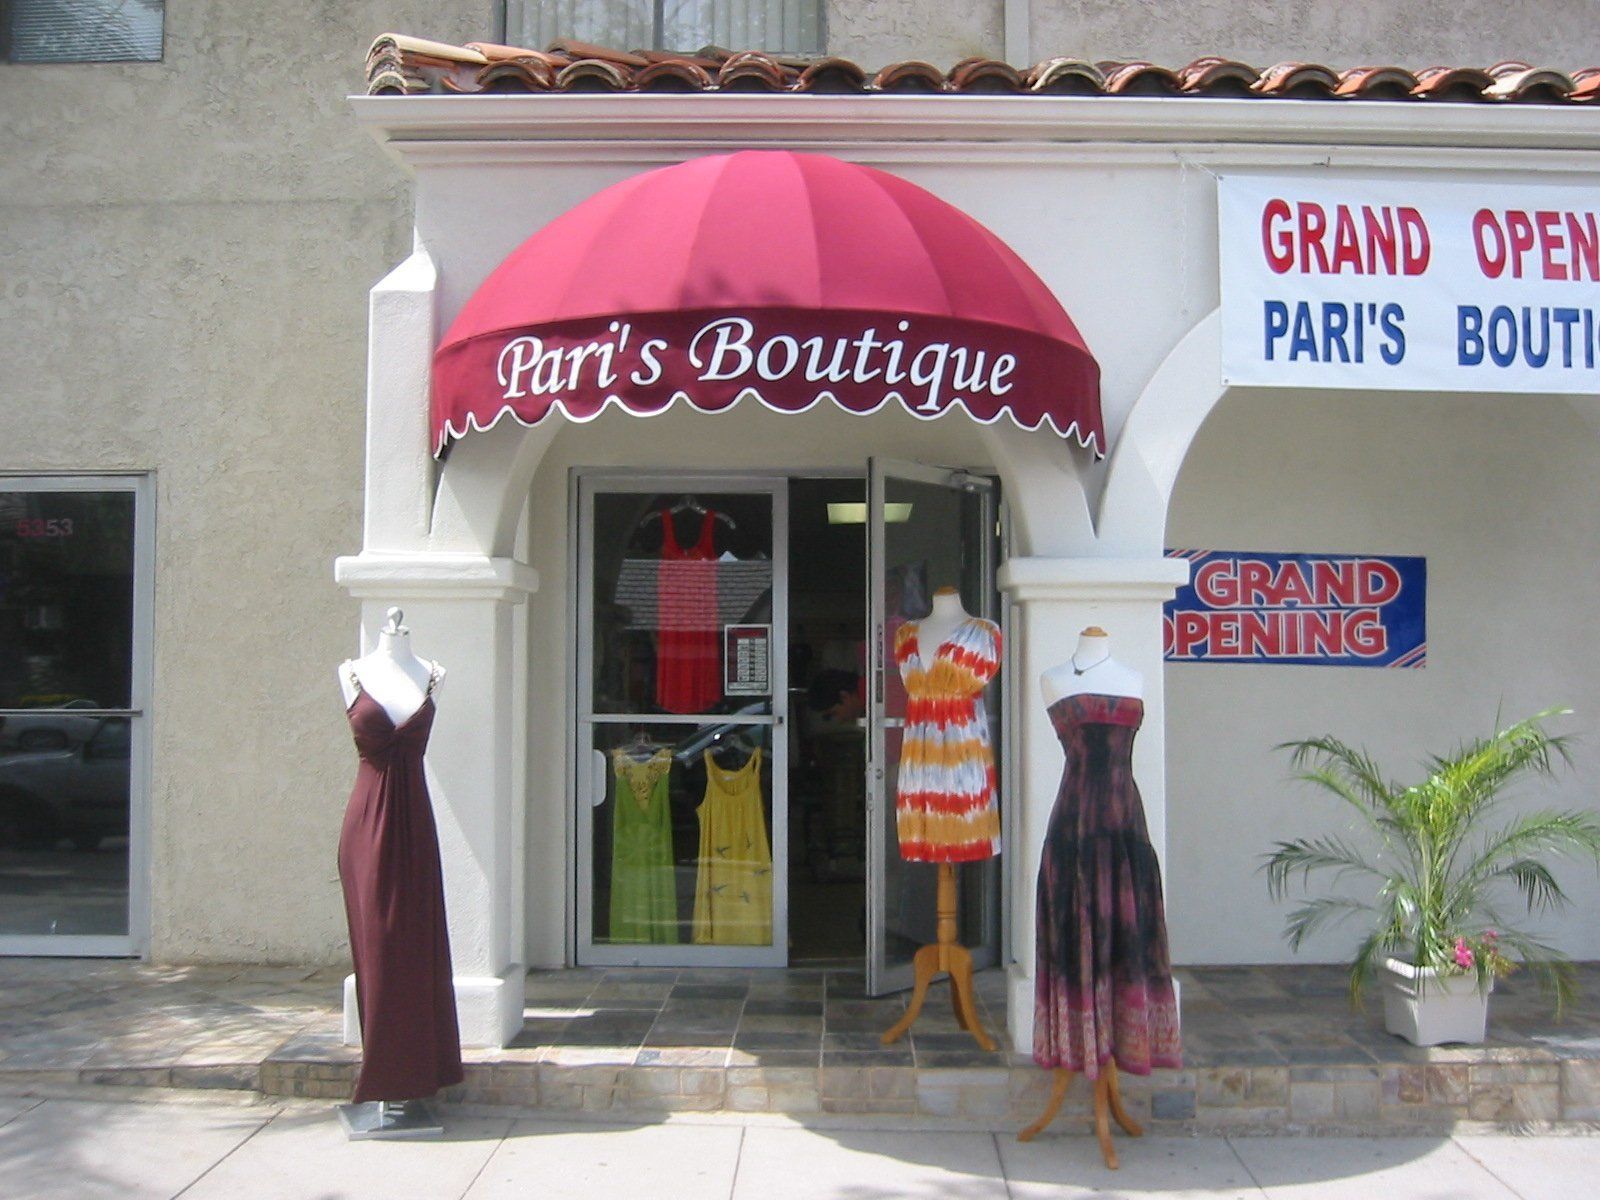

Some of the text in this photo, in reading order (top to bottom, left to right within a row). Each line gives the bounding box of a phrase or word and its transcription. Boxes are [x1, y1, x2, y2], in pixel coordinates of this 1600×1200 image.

[1262, 198, 1431, 276] GRAND
[497, 316, 1016, 411] Pari's Boutique
[1263, 300, 1600, 369] PARI'S BOUTI
[1194, 558, 1402, 609] GRAND
